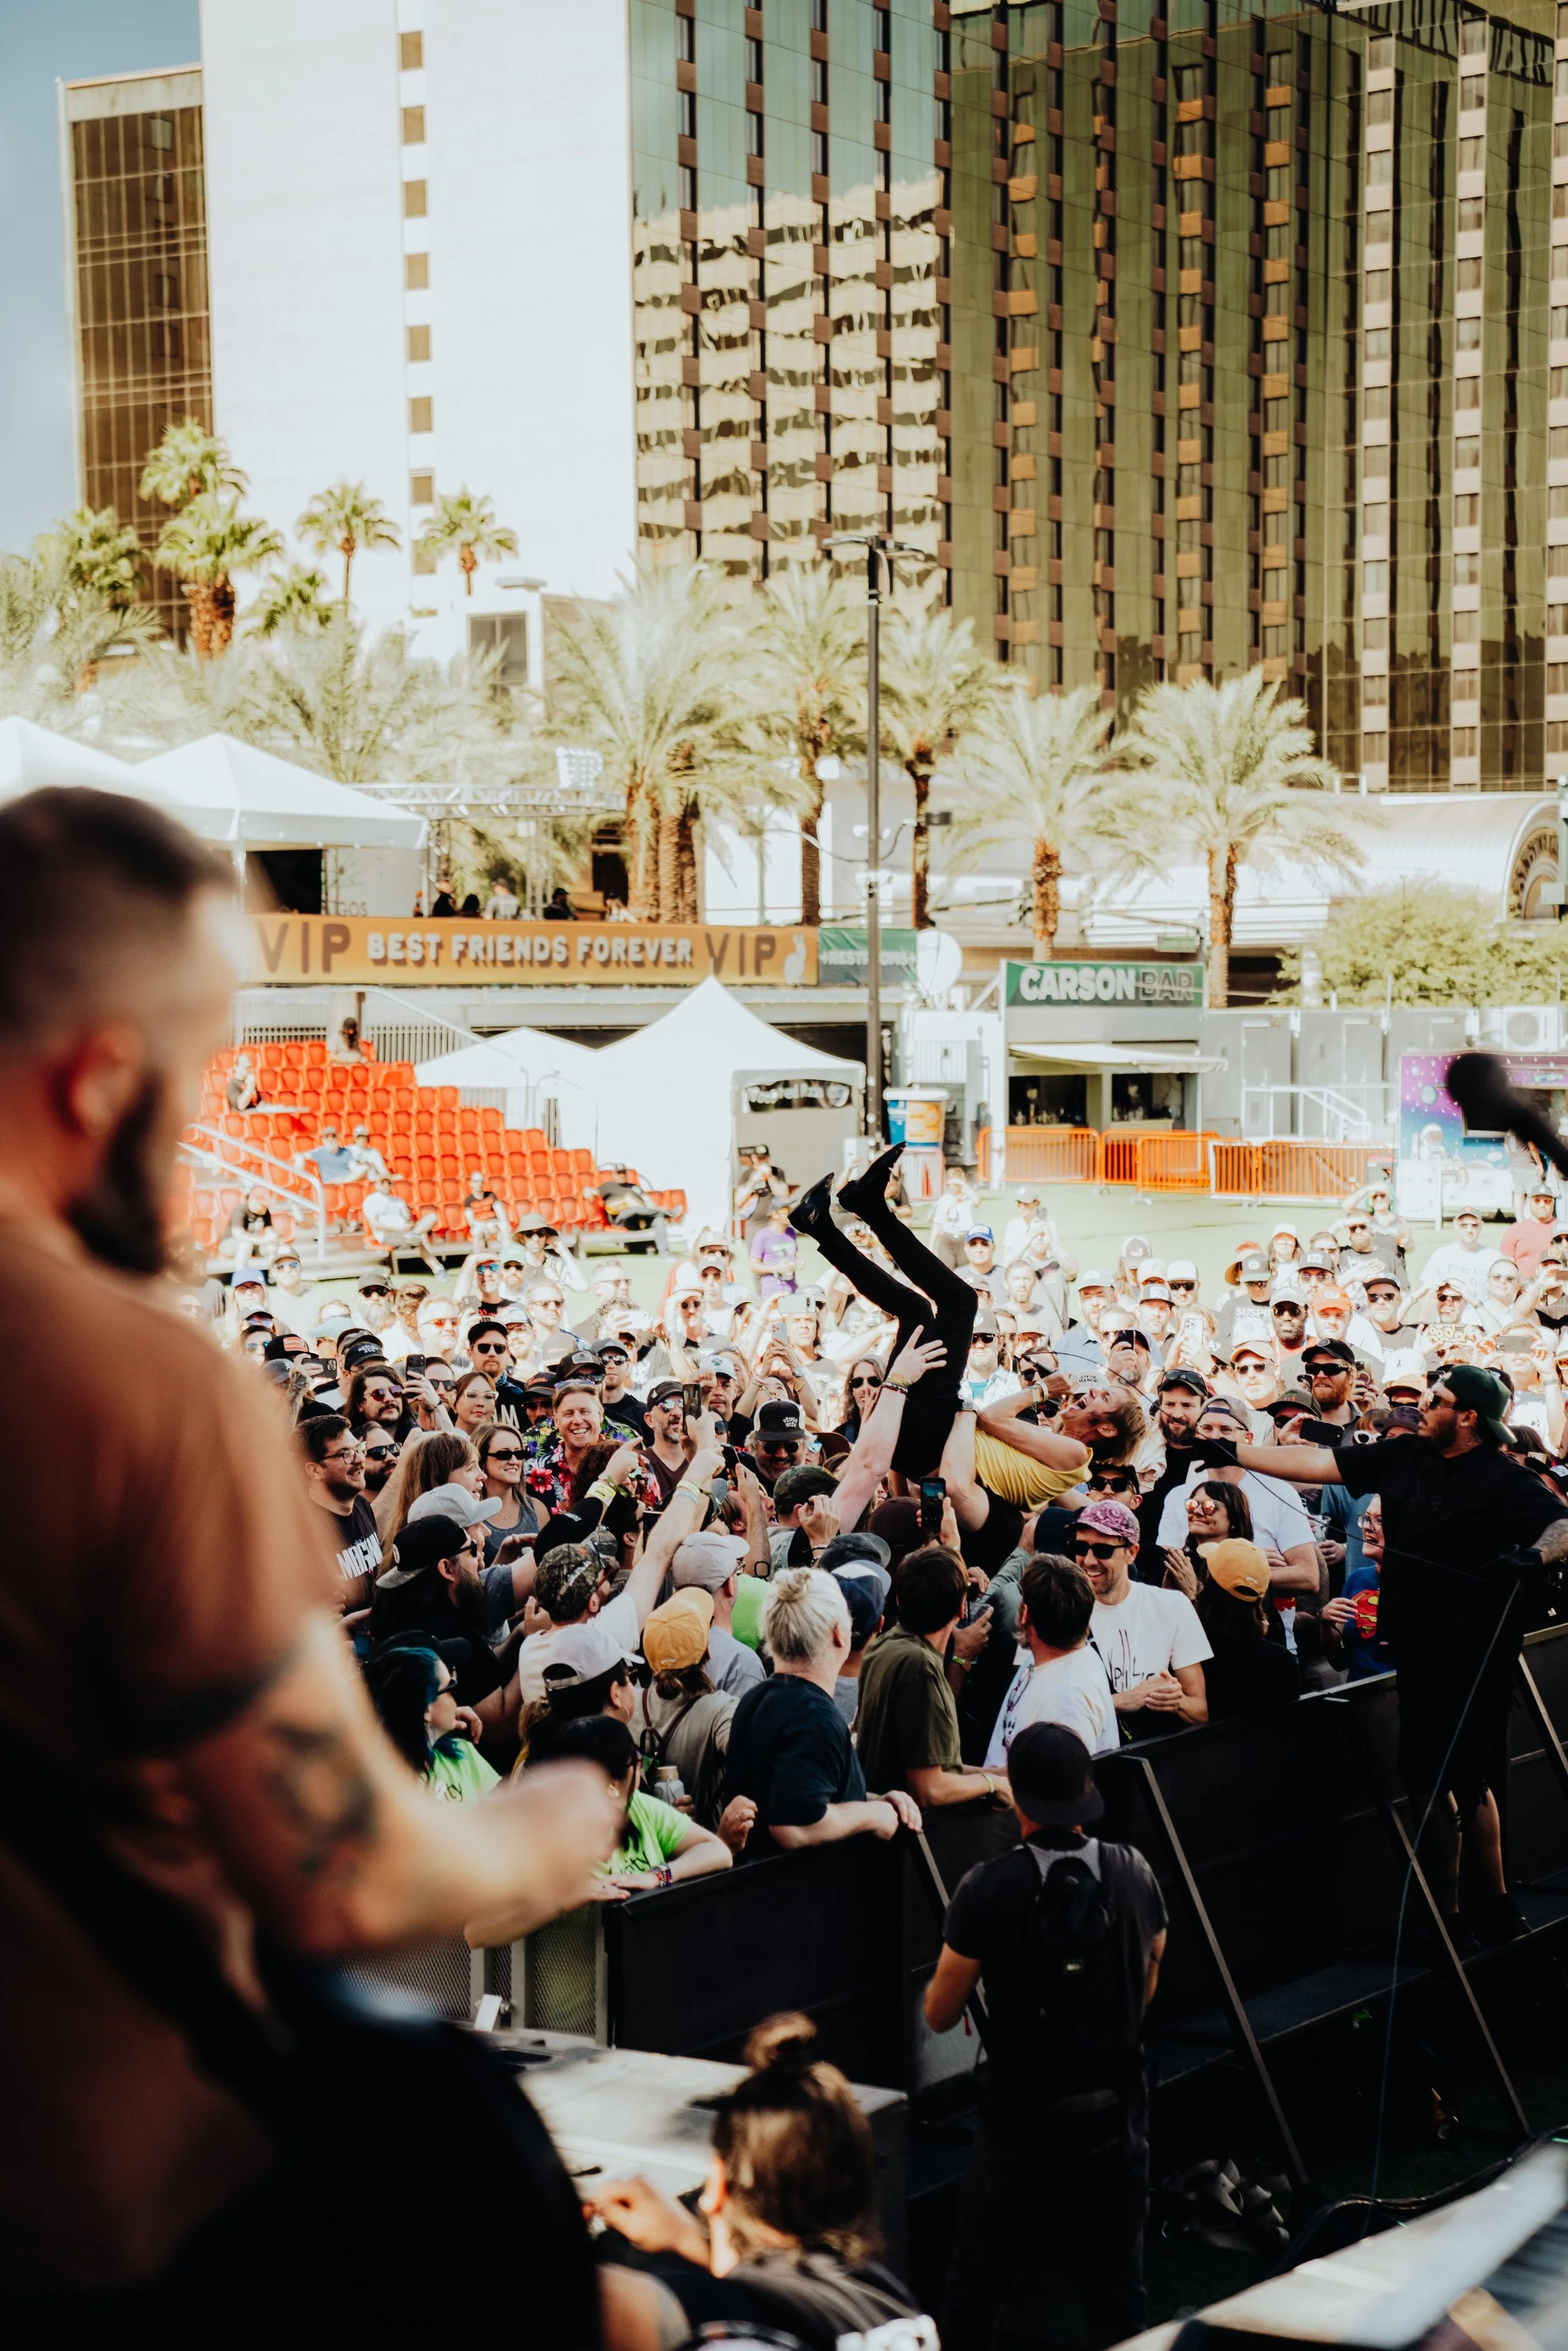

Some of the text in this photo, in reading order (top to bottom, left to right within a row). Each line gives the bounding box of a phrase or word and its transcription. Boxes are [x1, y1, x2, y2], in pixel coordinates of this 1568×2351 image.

[256, 921, 777, 976] VIP BEST FRIENDS FOREVER VIP
[1019, 967, 1194, 1002] CARSON BAR
